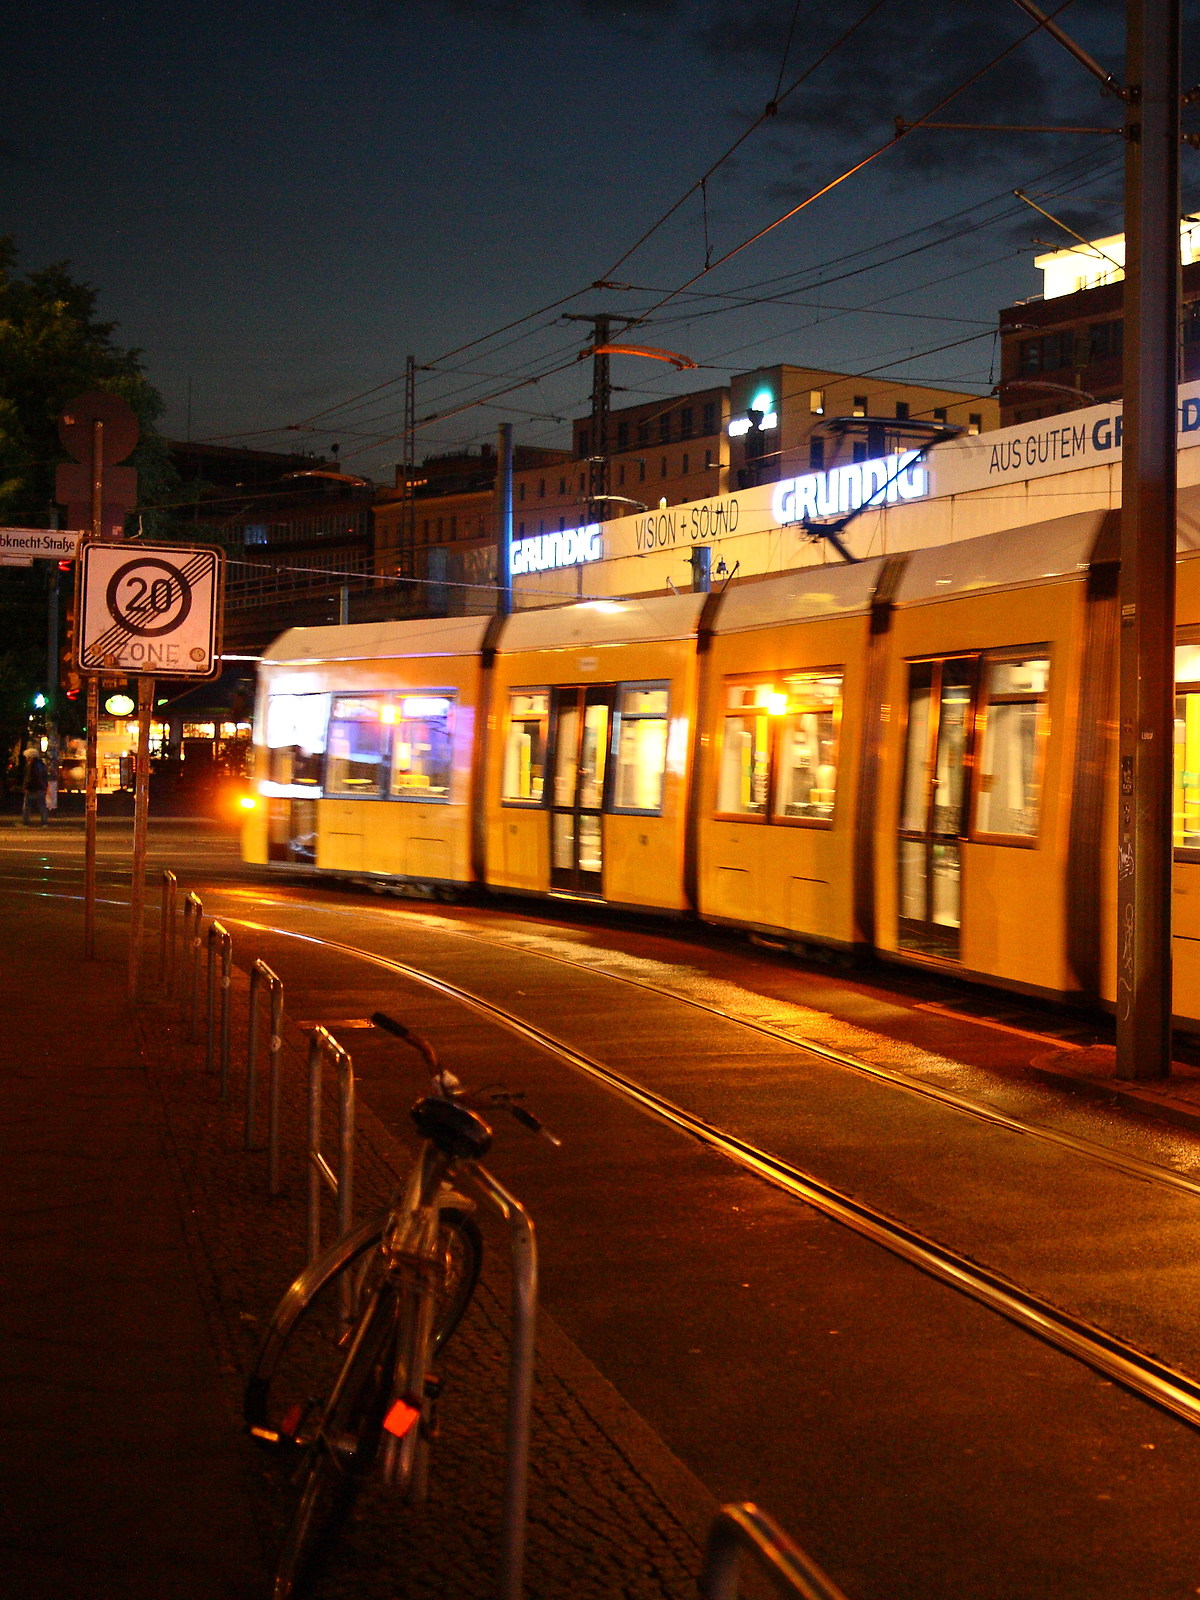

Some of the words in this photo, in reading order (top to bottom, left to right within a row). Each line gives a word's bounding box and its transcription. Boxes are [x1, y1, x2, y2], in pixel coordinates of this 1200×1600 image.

[989, 438, 1022, 474] AUS
[1025, 423, 1086, 466] GUTEM
[772, 449, 929, 524] GRUNDIG
[510, 522, 603, 575] GRUNDIG
[634, 511, 677, 551] VISION
[690, 498, 740, 541] SOUND
[125, 576, 173, 614] 20
[117, 642, 180, 664] ZONE
